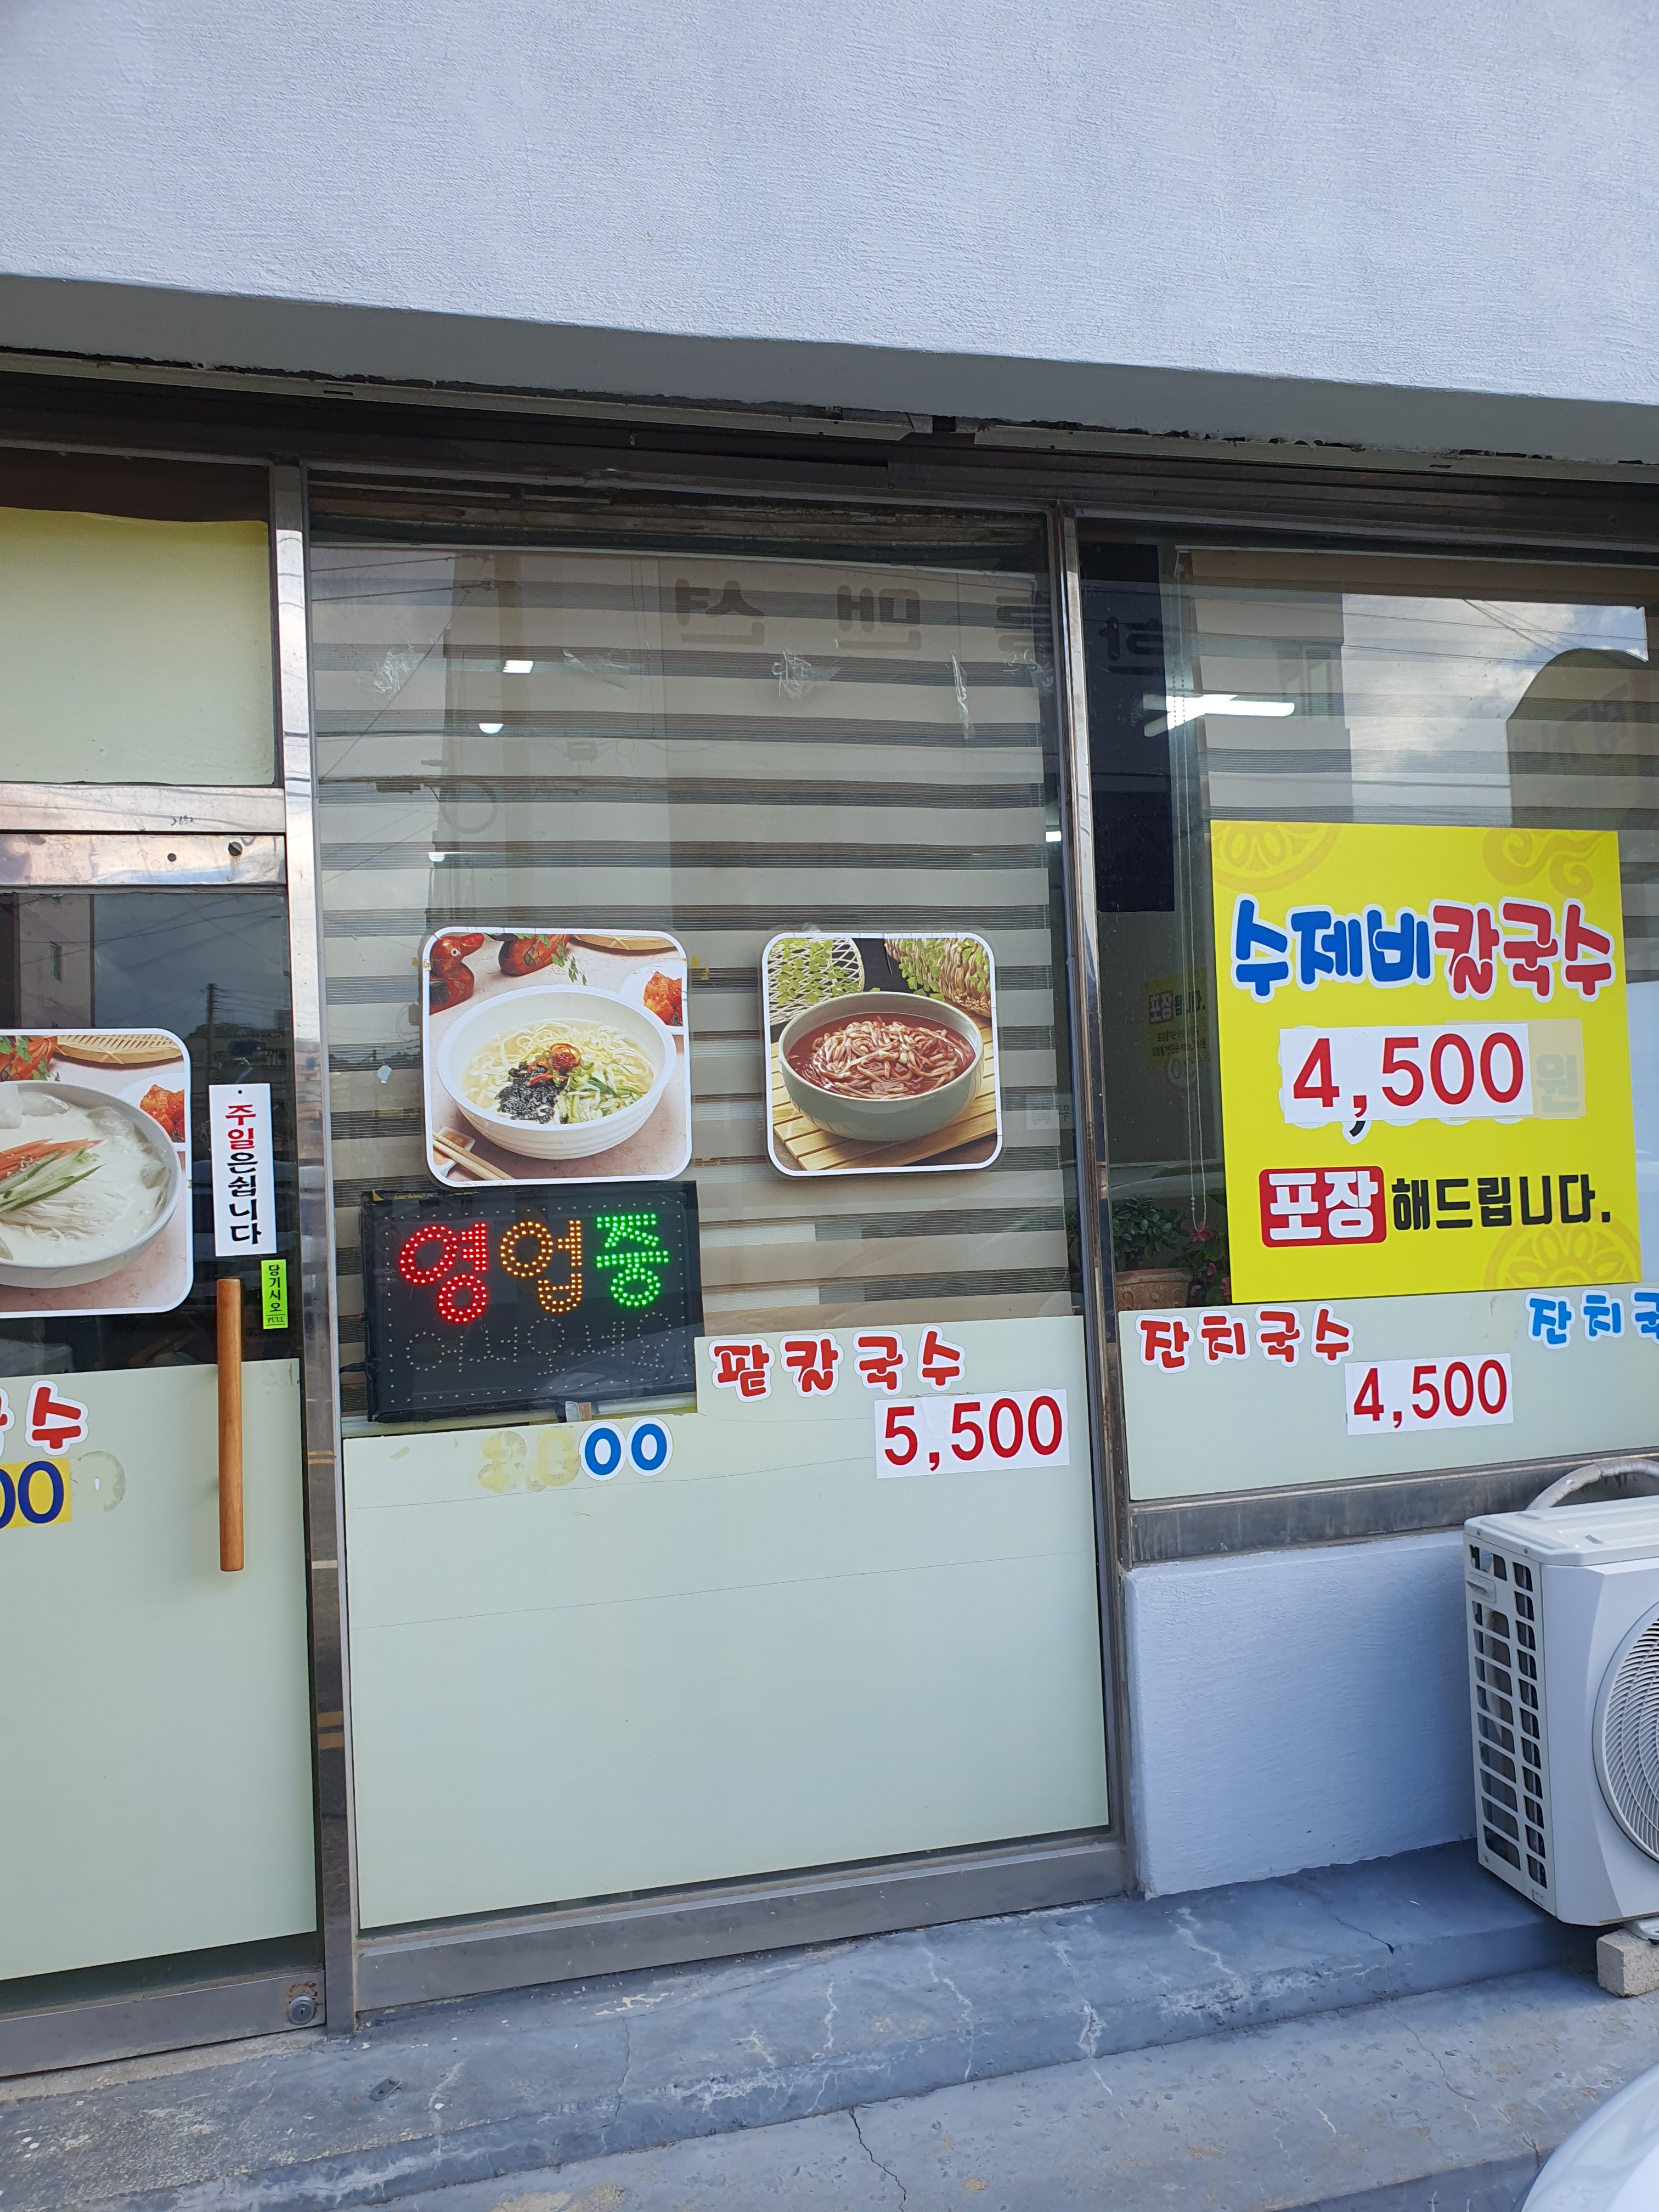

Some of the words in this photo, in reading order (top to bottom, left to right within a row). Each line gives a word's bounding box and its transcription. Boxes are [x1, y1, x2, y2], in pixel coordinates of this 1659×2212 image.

[1293, 1032, 1523, 1118] 4,500
[1268, 1170, 1379, 1240] 포장
[1391, 1173, 1611, 1231] 해드립니다.
[268, 1264, 281, 1312] 당기시오
[714, 1330, 960, 1397] 팥칼국수
[1140, 1308, 1349, 1368] 잔치국수
[1353, 1359, 1507, 1429] 4,500
[884, 1395, 1062, 1471] 5,500
